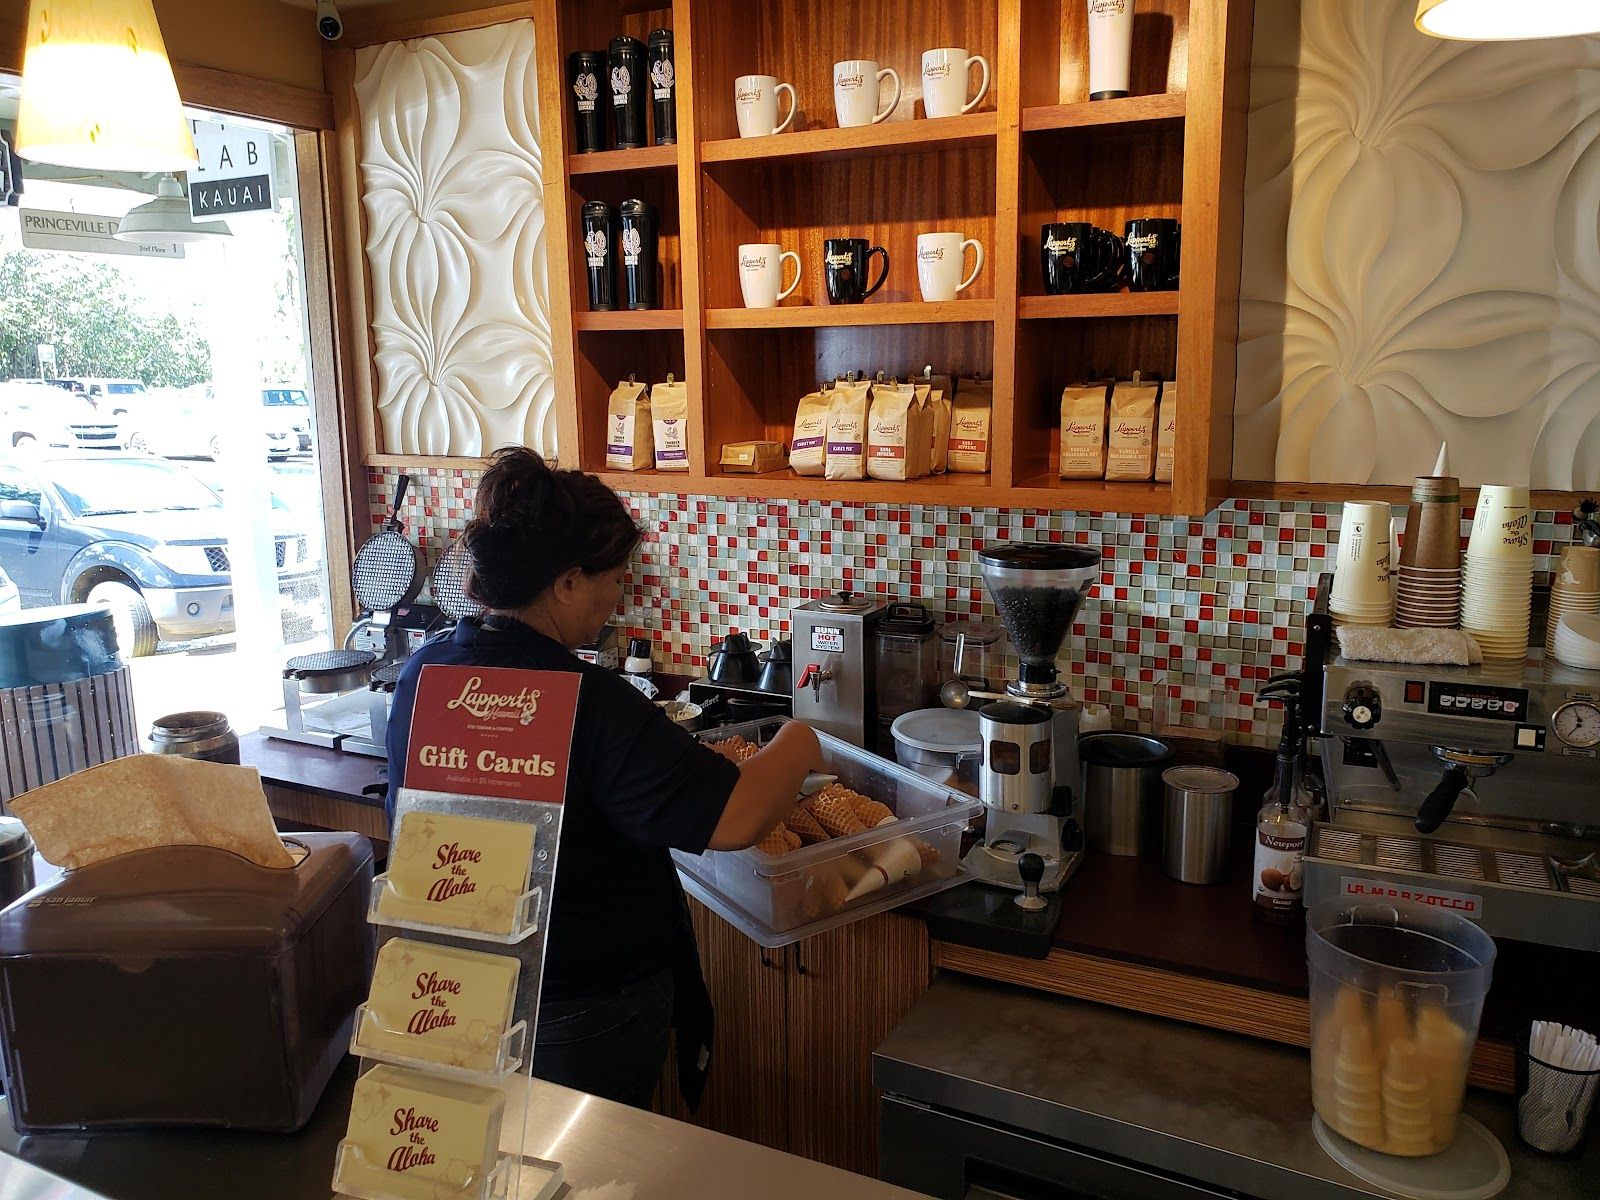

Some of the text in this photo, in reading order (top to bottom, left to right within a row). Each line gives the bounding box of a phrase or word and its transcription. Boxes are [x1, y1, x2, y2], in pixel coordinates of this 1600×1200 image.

[199, 184, 263, 209] KAUAI
[25, 215, 106, 235] PRINCEVILLE
[1503, 532, 1529, 547] Share
[815, 626, 840, 634] BUNN
[447, 676, 541, 717] Lappert's
[419, 745, 556, 777] Gift Cards
[1264, 835, 1304, 850] Newport
[432, 842, 482, 870] Share
[451, 865, 467, 876] the
[427, 876, 477, 902] Aloha
[411, 971, 461, 1000] Share
[431, 995, 447, 1008] the
[406, 1009, 456, 1035] Aloha
[389, 1107, 439, 1136] Share
[409, 1133, 425, 1146] the
[386, 1146, 436, 1172] Aloha
